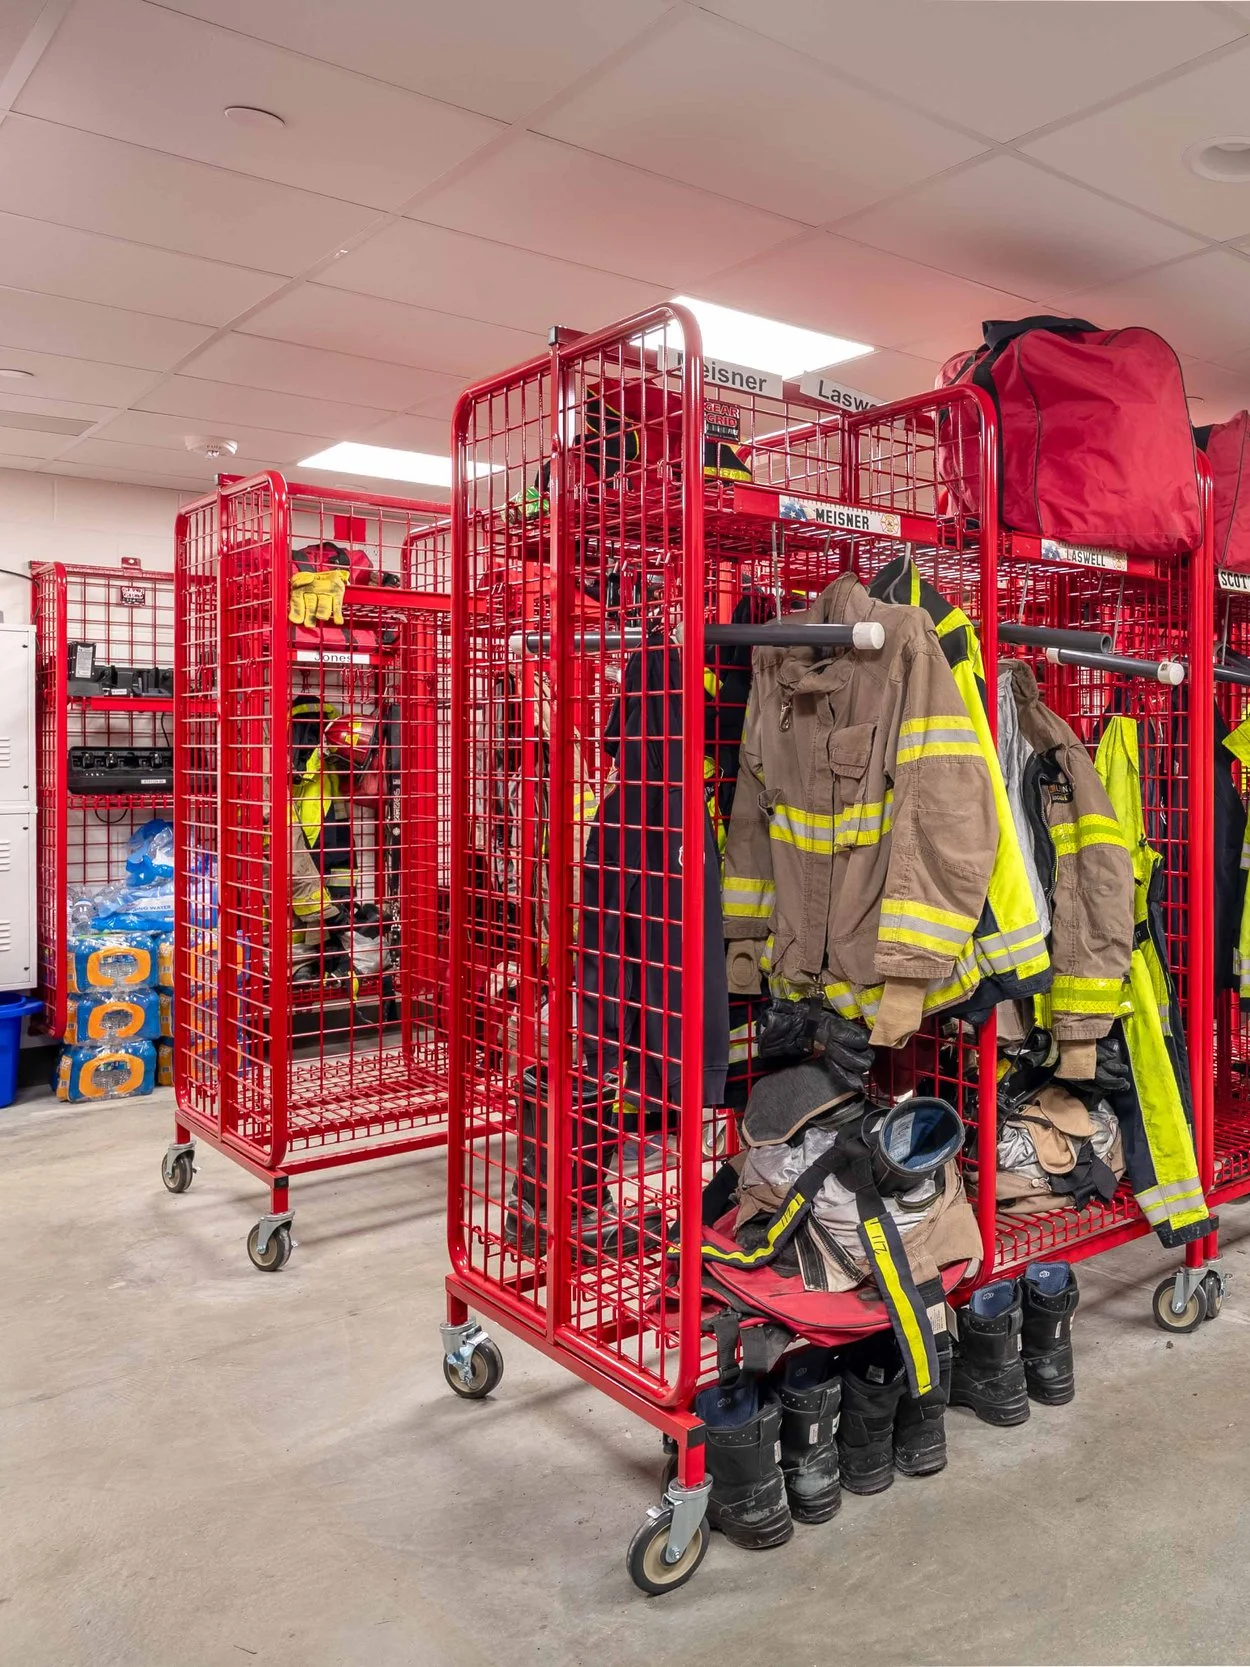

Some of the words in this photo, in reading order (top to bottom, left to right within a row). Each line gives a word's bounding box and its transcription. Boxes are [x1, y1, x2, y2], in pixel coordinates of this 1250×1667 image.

[704, 401, 740, 419] GEAR
[706, 413, 738, 428] GRID
[815, 507, 870, 530] MEISNER
[1066, 549, 1106, 567] LASWELL
